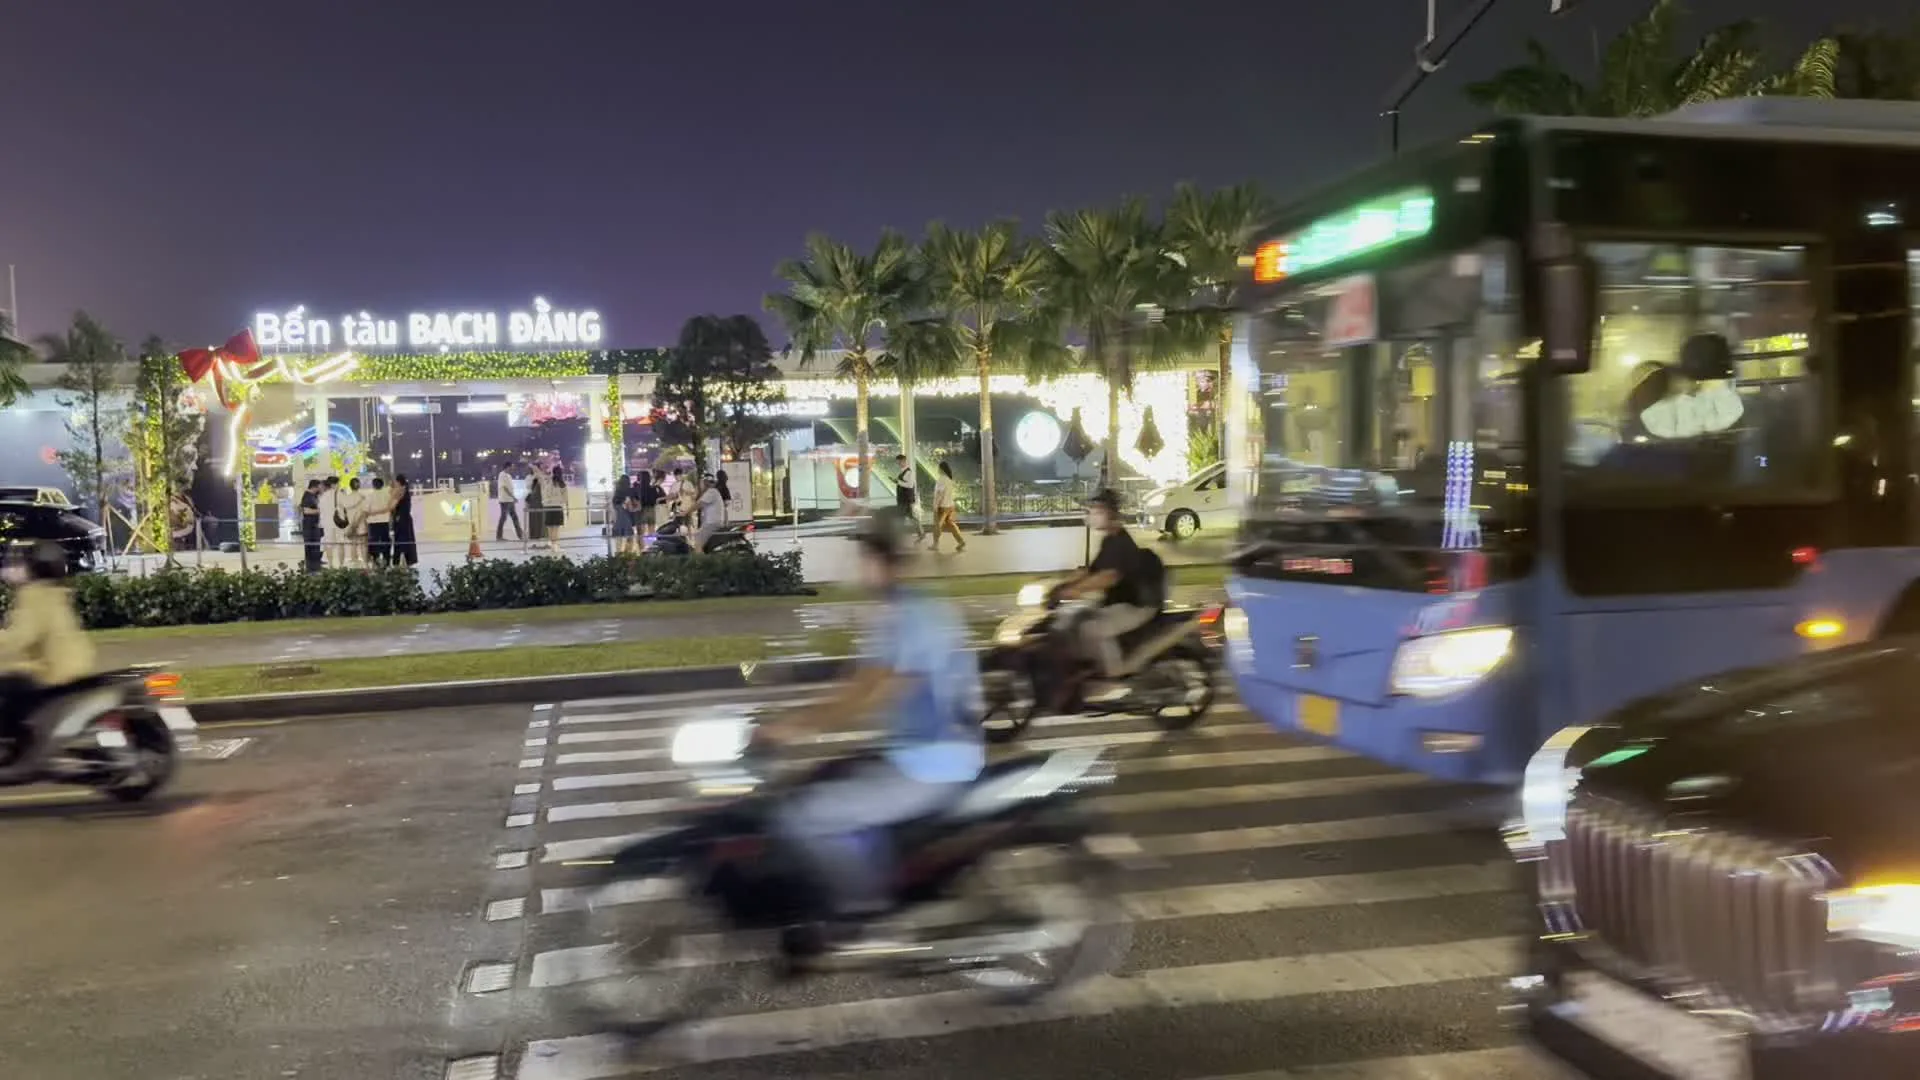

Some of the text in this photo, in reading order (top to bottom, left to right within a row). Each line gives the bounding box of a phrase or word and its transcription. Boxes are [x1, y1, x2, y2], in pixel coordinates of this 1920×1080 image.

[256, 304, 331, 345] Bến
[342, 311, 398, 345] tàu
[409, 311, 497, 352] BẠCH
